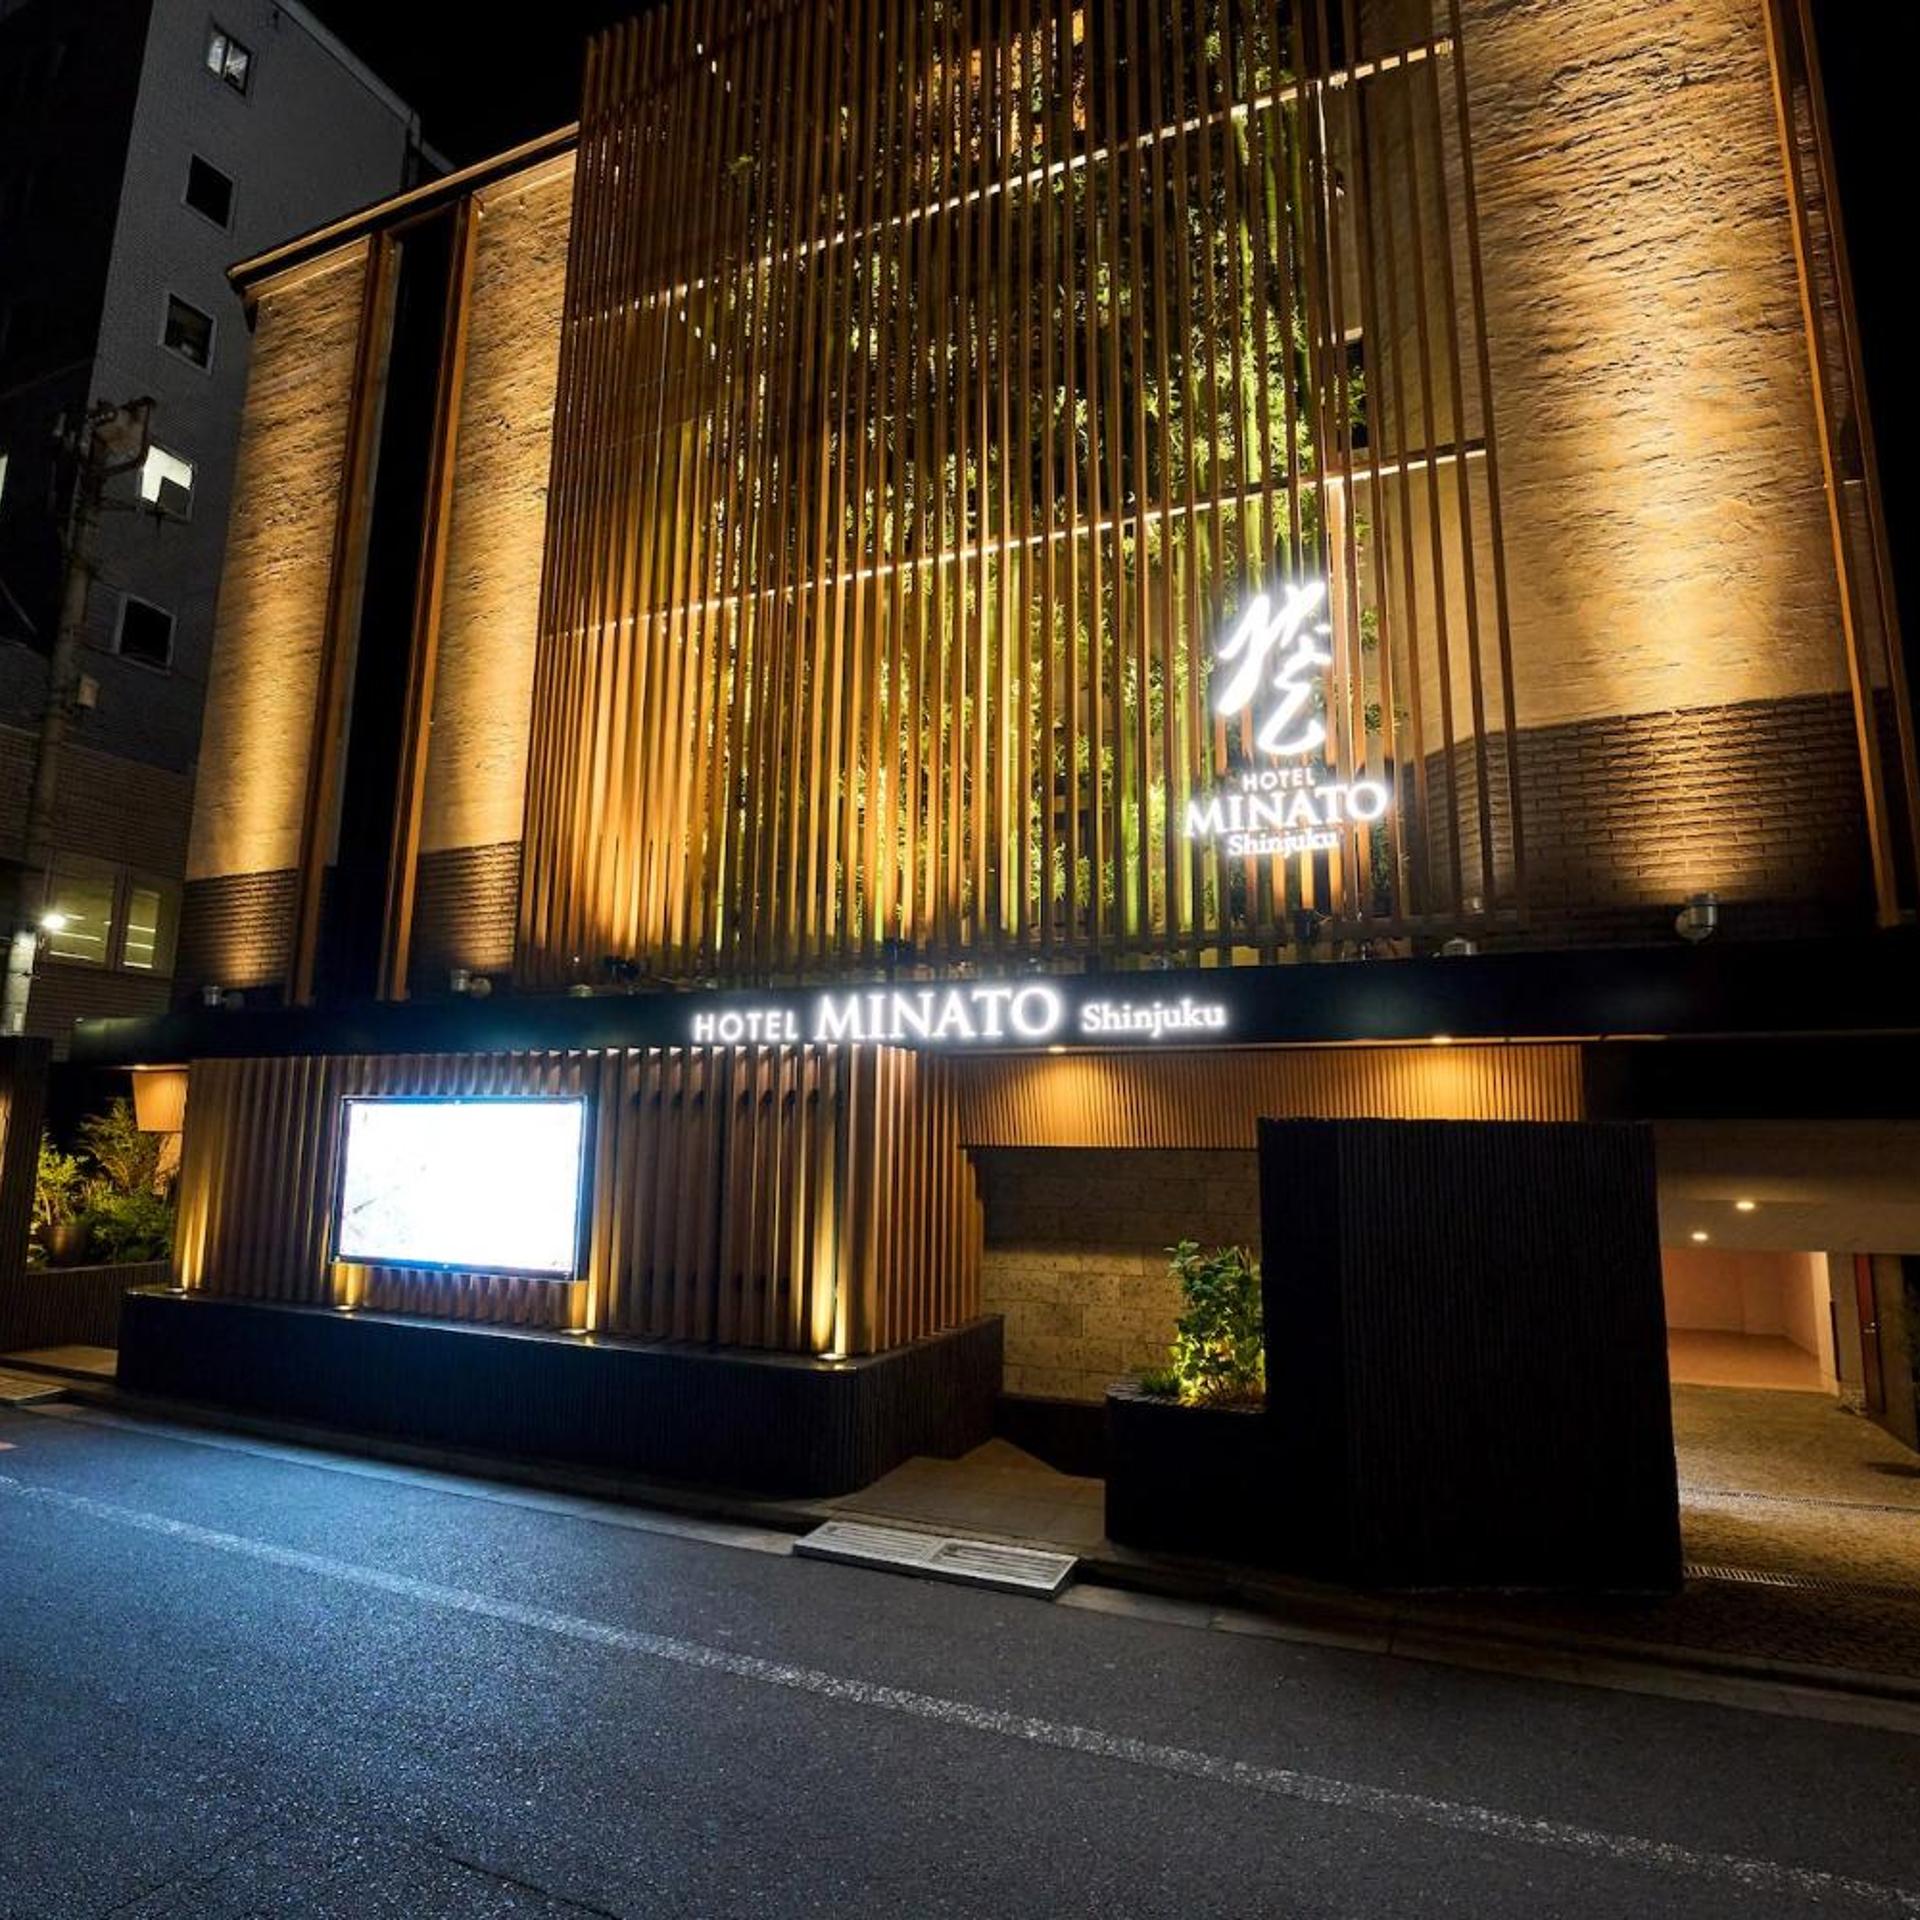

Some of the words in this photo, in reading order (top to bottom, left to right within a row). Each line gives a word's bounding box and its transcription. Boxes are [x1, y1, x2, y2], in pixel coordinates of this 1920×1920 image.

[1242, 768, 1315, 791] HOTEL
[1184, 782, 1388, 838] MINATO
[1227, 830, 1340, 857] Shinjuku
[694, 1012, 798, 1042] HOTEL
[815, 987, 1061, 1040] MINATO
[1082, 999, 1226, 1037] Shinjuku
